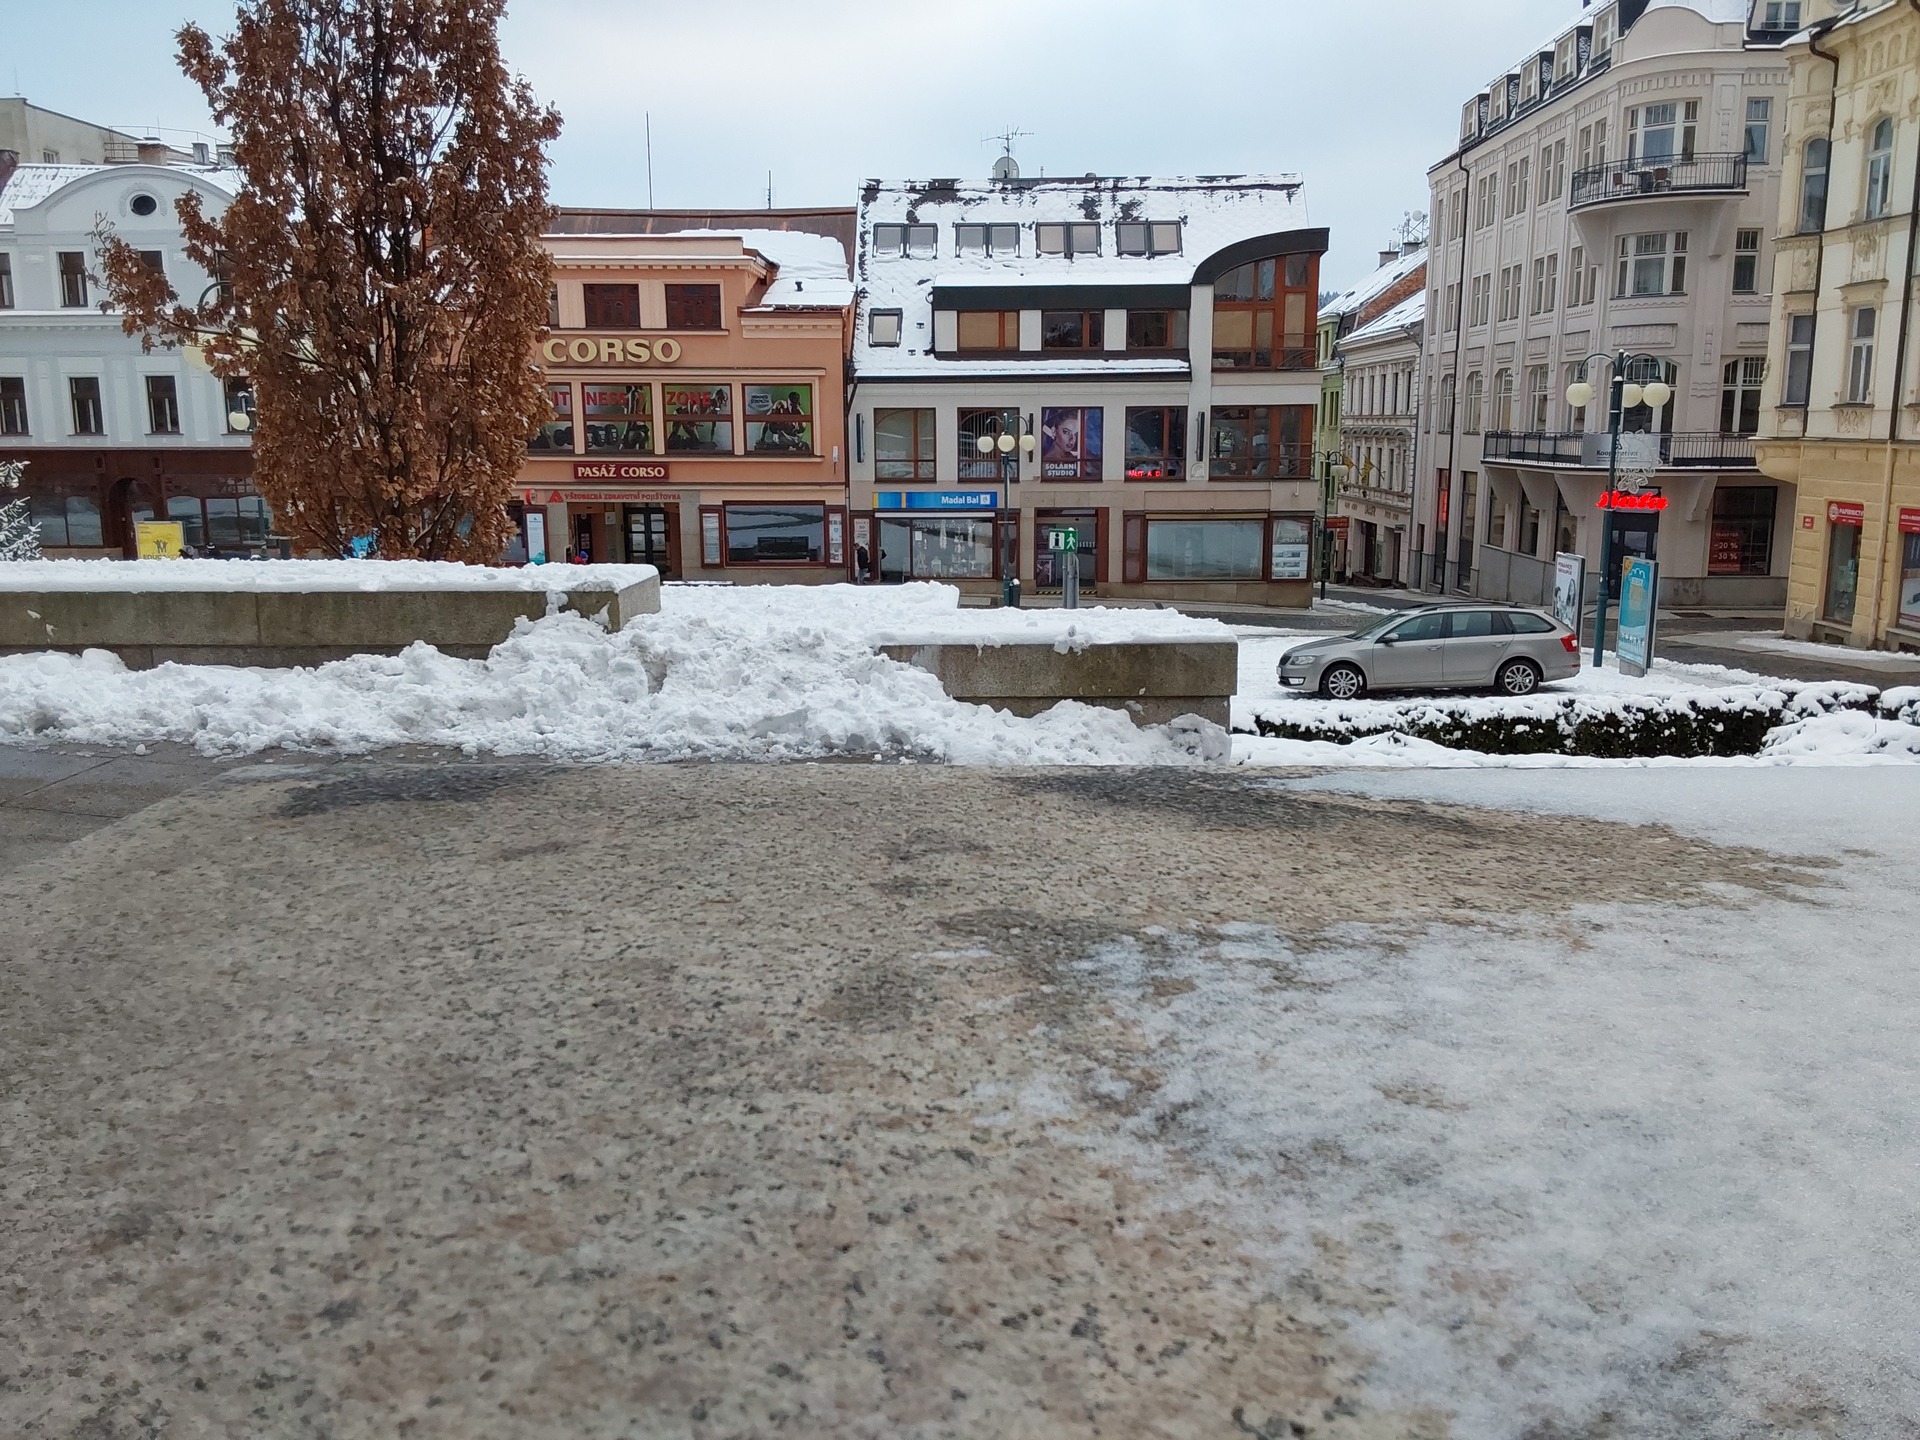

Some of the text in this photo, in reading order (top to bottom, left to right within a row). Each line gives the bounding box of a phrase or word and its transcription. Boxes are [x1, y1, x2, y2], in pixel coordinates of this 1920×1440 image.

[543, 338, 681, 363] CORSO
[577, 464, 665, 478] PASÁŽ CORSO
[1047, 469, 1075, 477] STUDIO
[565, 492, 681, 501] VŠEOBECNÁ ZDRAVOTNÍ POJIŠŤOVNA
[941, 496, 979, 504] Madal Bal
[1713, 552, 1738, 560] -30 %
